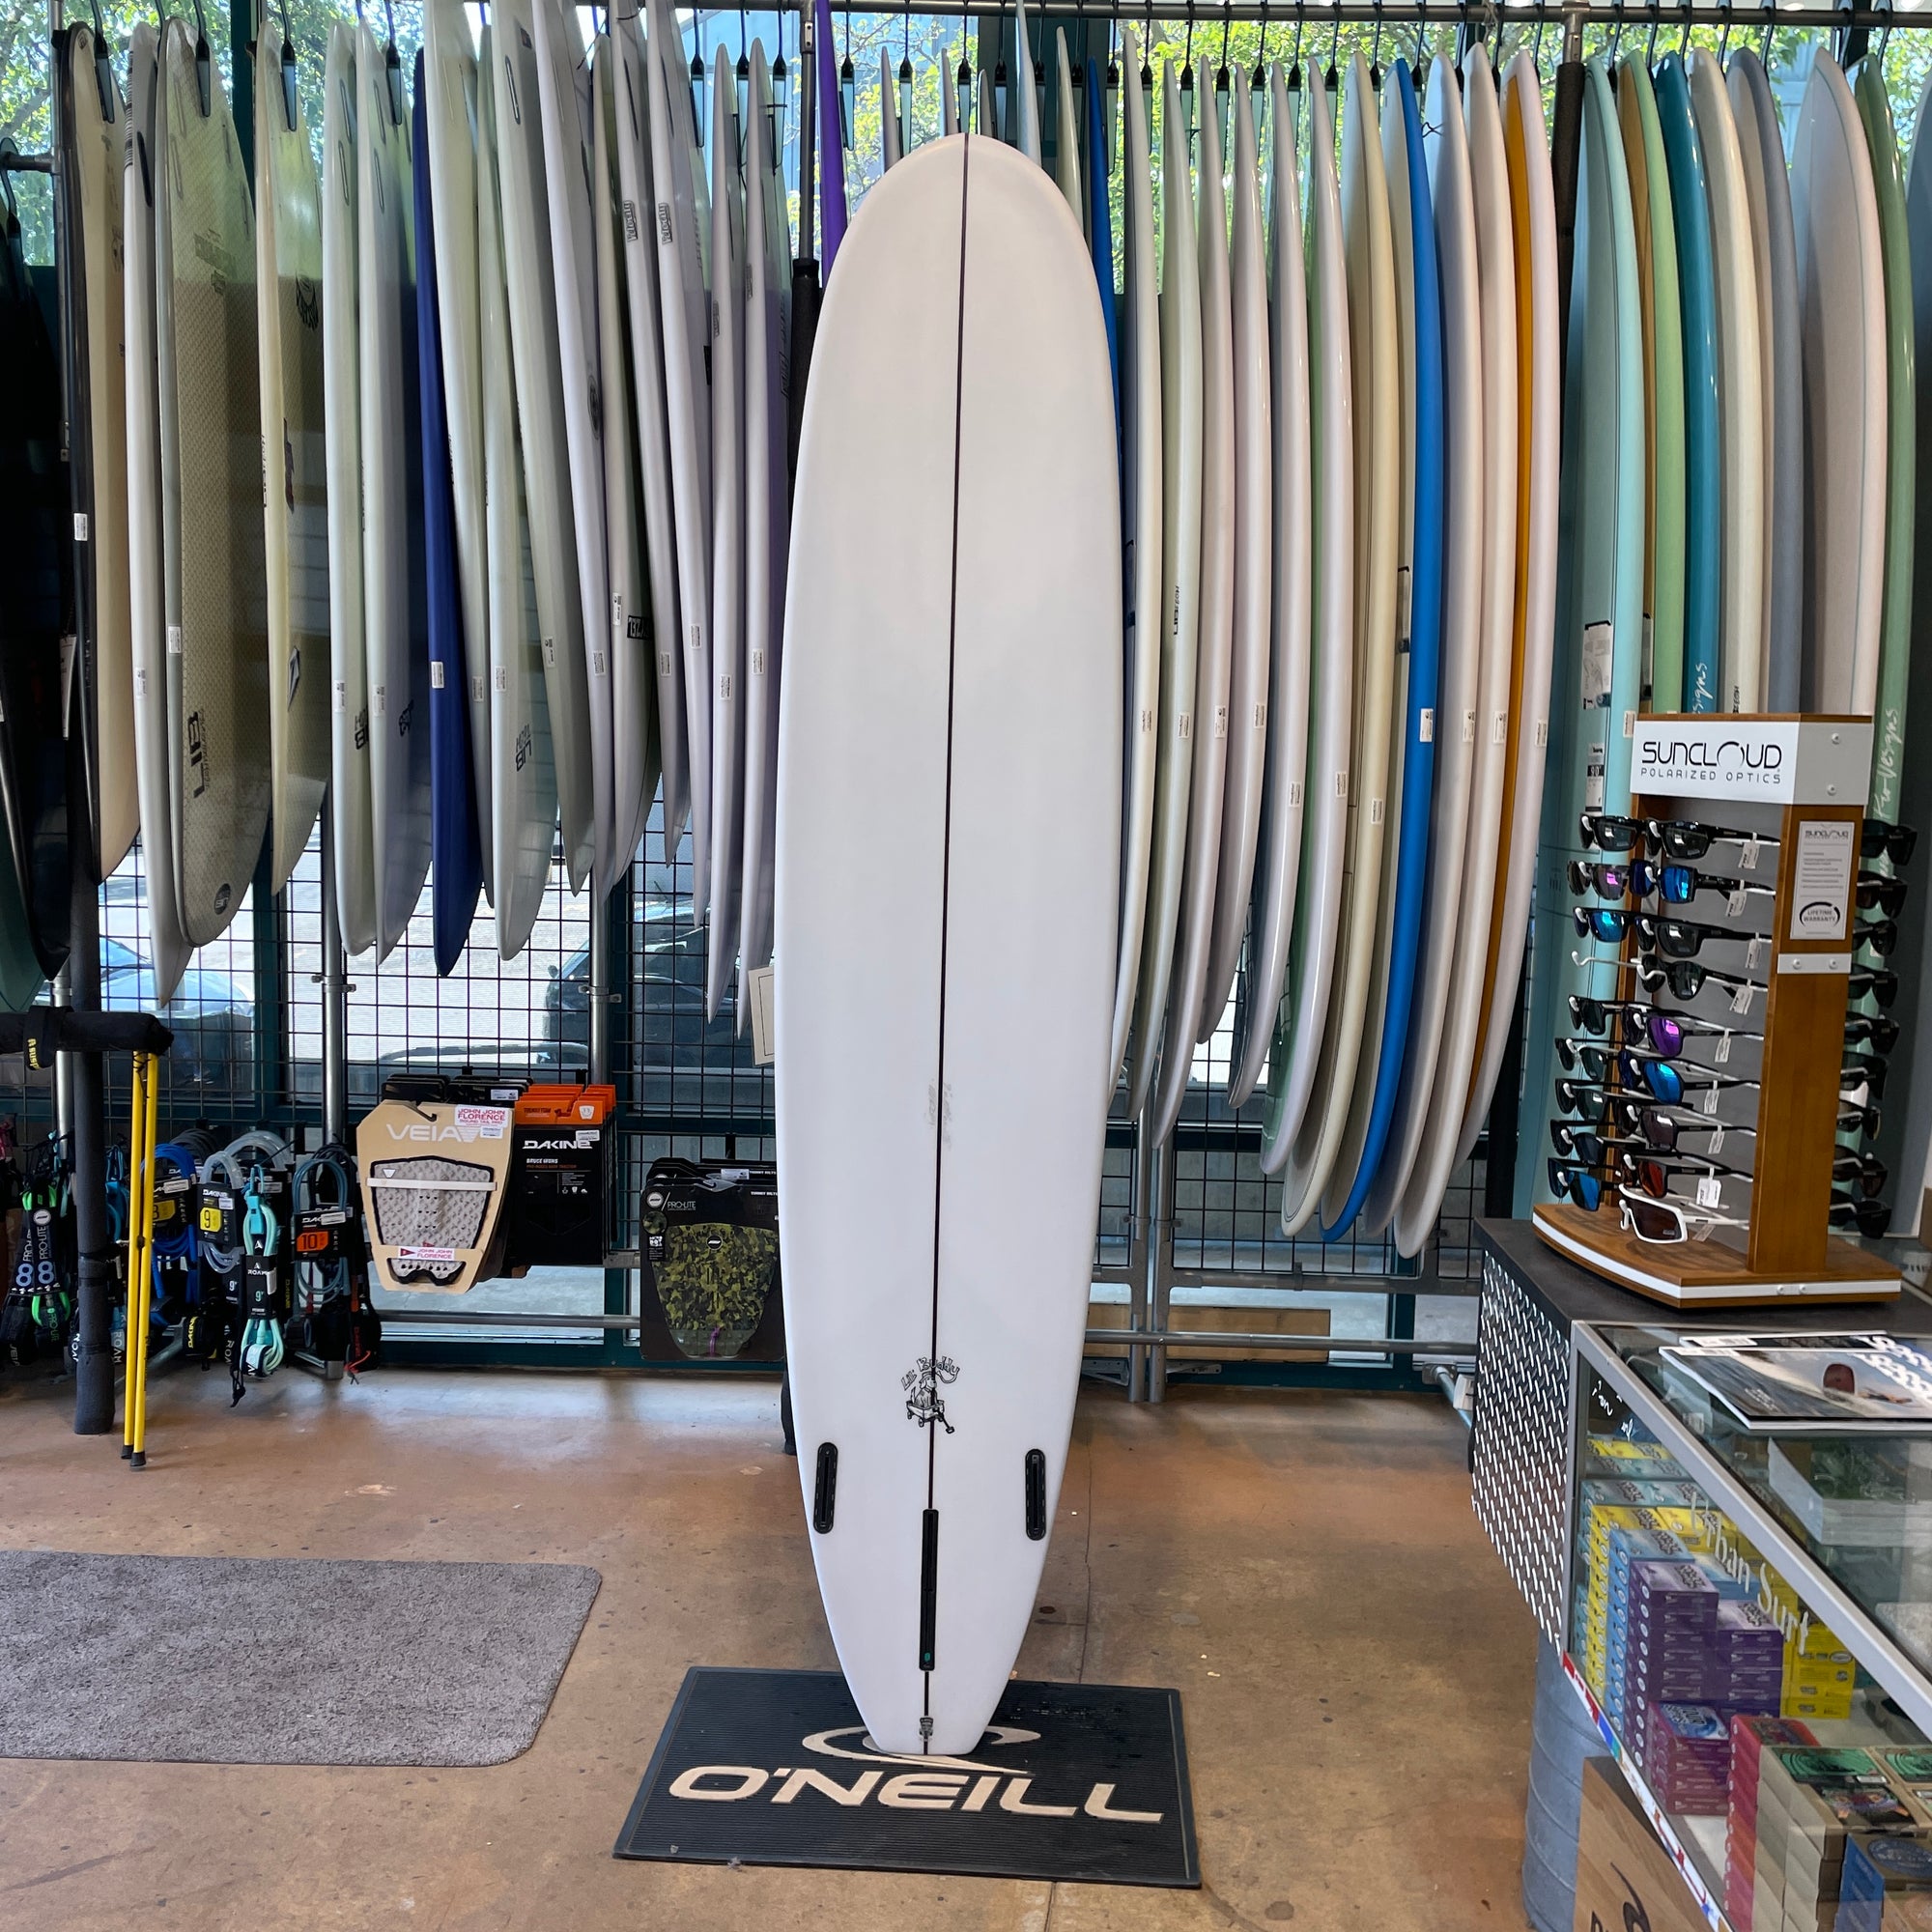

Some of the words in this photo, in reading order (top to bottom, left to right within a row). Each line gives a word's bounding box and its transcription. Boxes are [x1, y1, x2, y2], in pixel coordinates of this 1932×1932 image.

[1692, 662, 1714, 714] signs
[187, 712, 205, 798] LIB
[1641, 741, 1782, 769] SUNCLOUD
[1641, 767, 1717, 781] POLARIZED
[1725, 771, 1781, 784] OPTICS
[386, 1123, 463, 1143] VEIA
[523, 1140, 593, 1150] DAKINE
[204, 1209, 211, 1228] 9
[37, 1225, 48, 1260] PRO-LITE
[301, 1234, 318, 1250] 10
[113, 1331, 123, 1364] ROAM
[916, 1355, 961, 1383] Buddy
[669, 1765, 1164, 1822] O'NEILL
